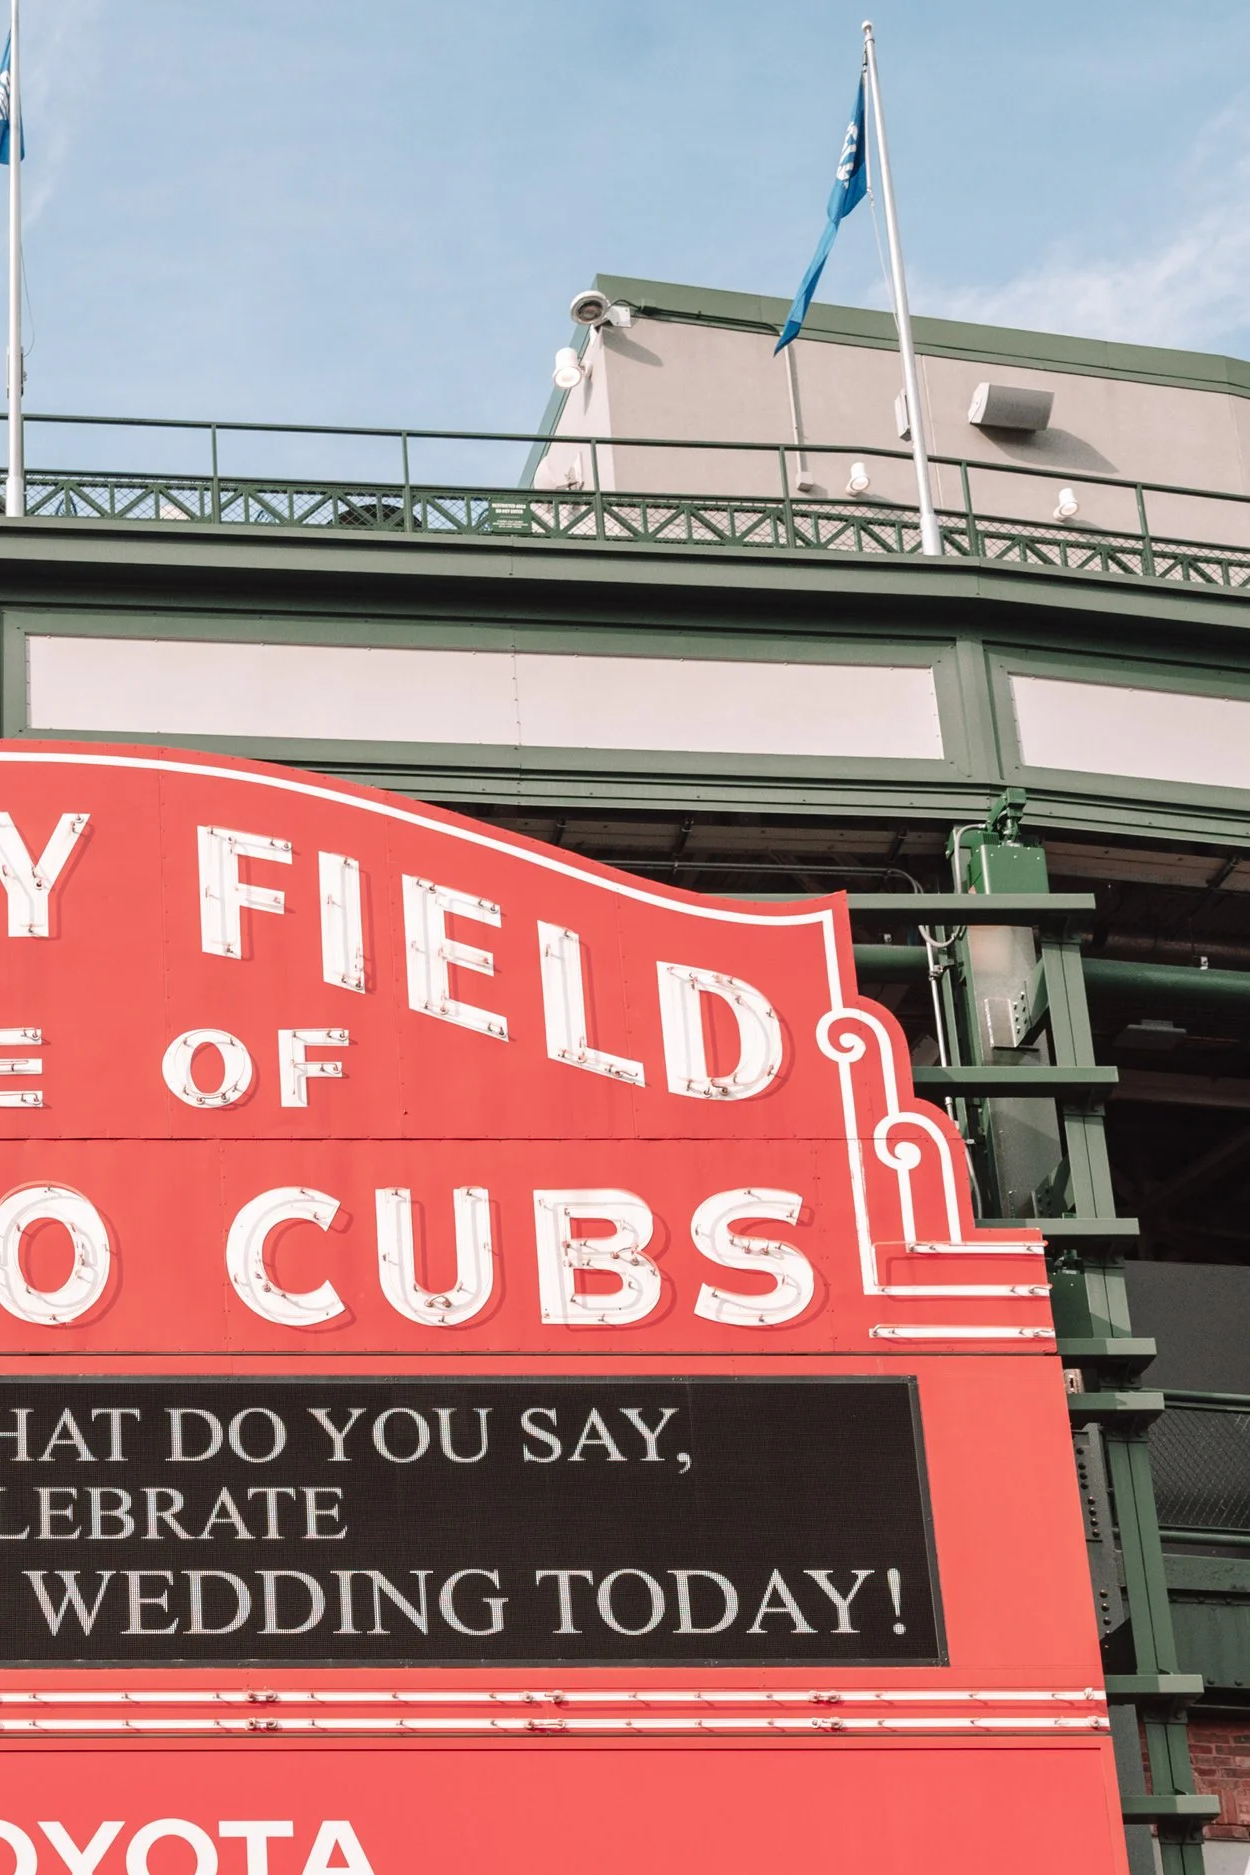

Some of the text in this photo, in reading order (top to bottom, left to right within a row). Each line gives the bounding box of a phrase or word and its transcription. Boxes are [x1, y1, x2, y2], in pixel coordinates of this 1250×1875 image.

[196, 824, 783, 1102] FIELD
[161, 1028, 351, 1108] OF
[225, 1186, 816, 1327] CUBS
[164, 1407, 289, 1463] DO
[308, 1407, 493, 1463] YOU
[521, 1406, 694, 1474] SAY,
[21, 1568, 510, 1639] WEDDING
[534, 1566, 908, 1637] TODAY!
